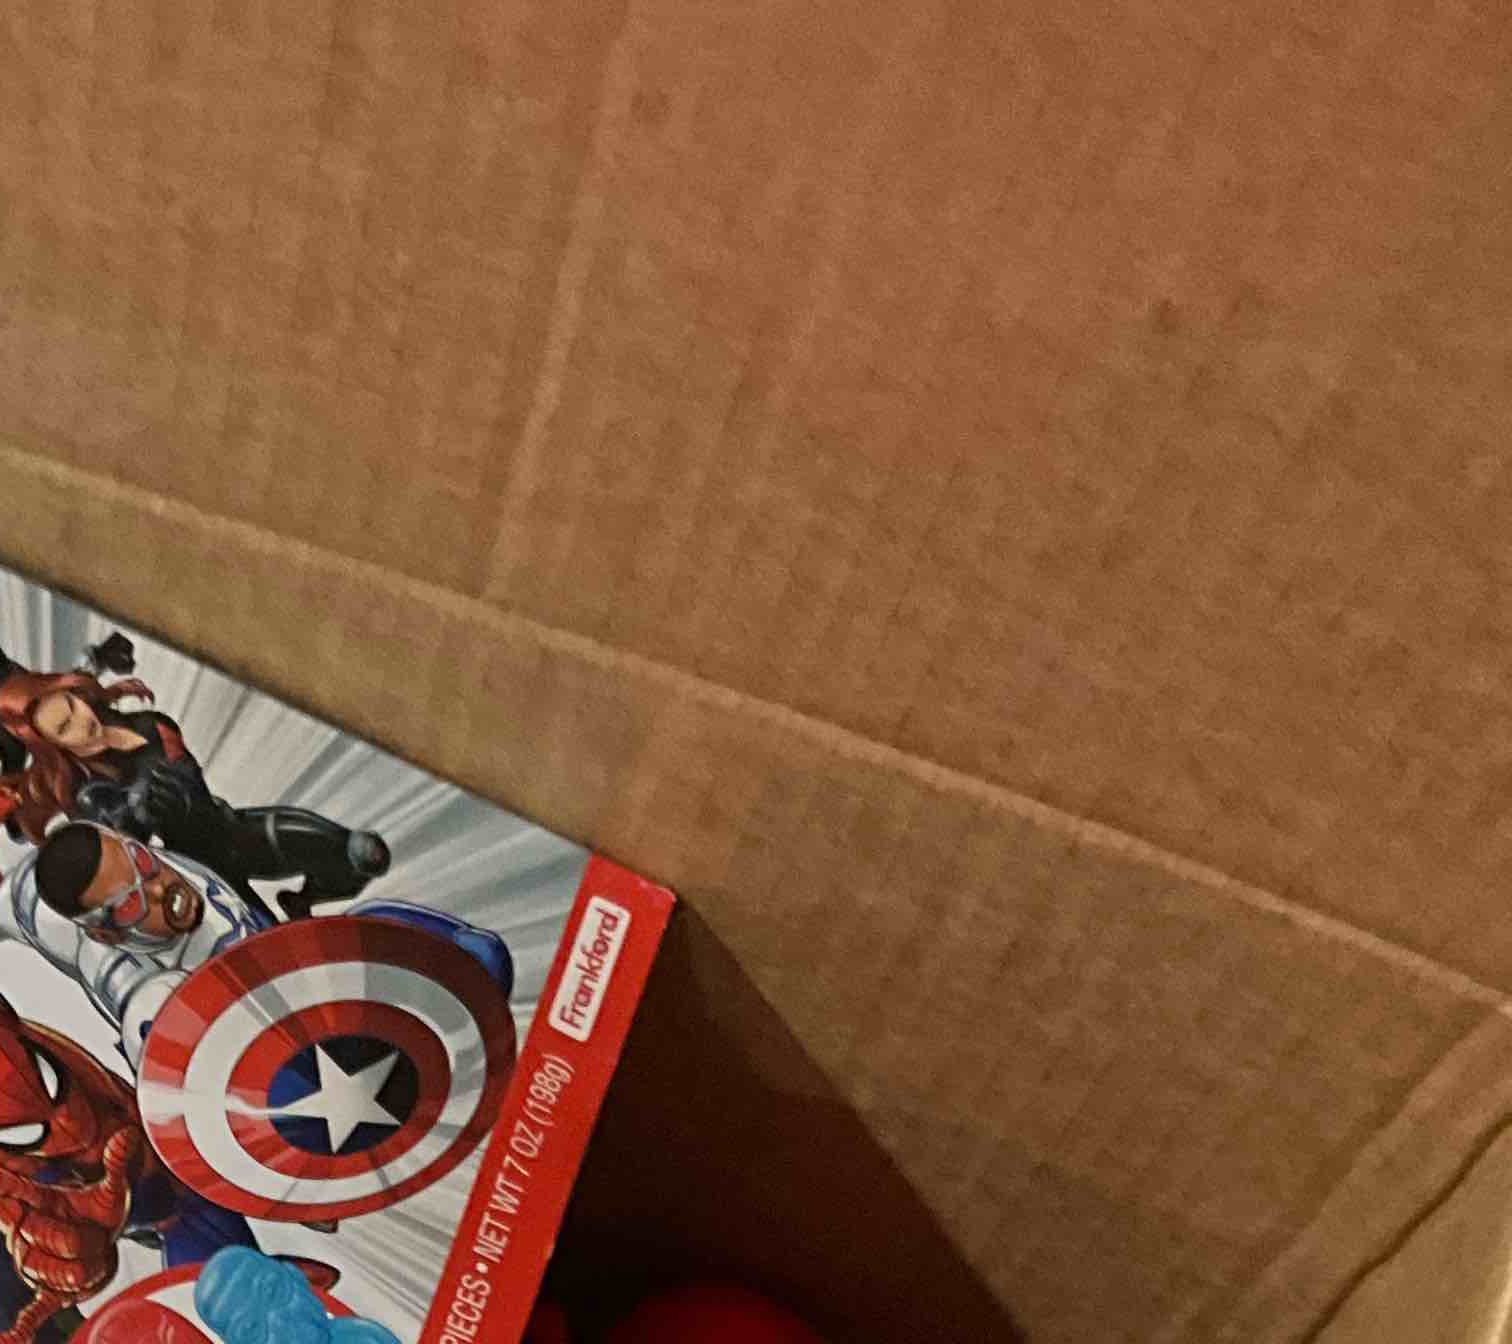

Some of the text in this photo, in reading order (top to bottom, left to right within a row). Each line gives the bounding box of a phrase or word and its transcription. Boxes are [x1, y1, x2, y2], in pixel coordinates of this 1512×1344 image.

[560, 906, 619, 1029] Frankford
[522, 1053, 575, 1127] (198g)
[510, 1119, 544, 1159] OZ
[504, 1154, 531, 1178] 7
[487, 1172, 520, 1216] WT
[473, 1211, 510, 1264] NET
